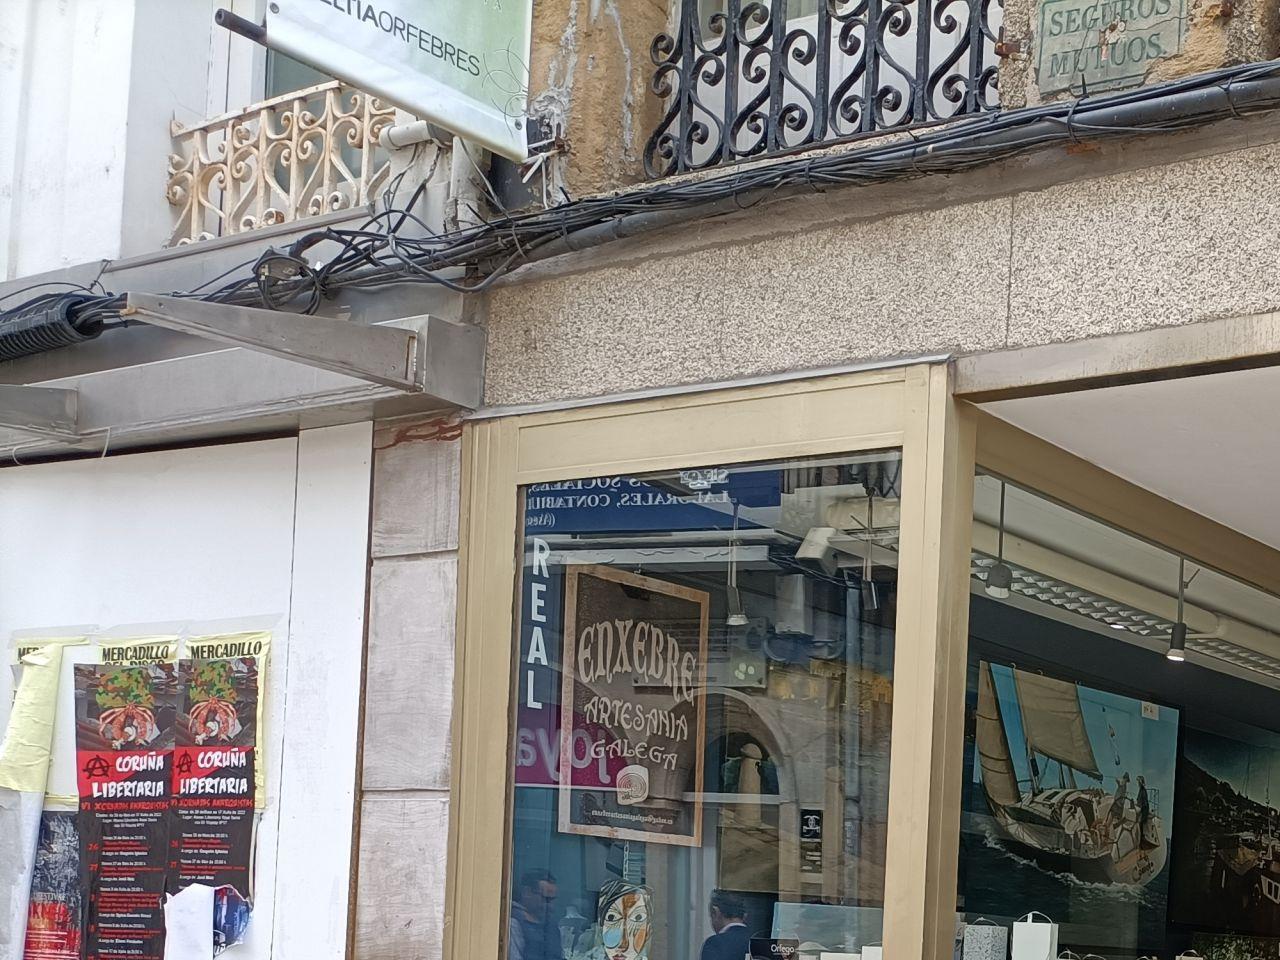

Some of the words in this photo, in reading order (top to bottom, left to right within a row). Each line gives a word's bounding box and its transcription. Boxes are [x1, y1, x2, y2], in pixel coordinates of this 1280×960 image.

[103, 645, 169, 661] MERCADILLO
[191, 641, 262, 659] MERCADILLO
[577, 618, 697, 706] ENXEBRE
[584, 695, 689, 742] ARTESANIA
[116, 751, 164, 772] CORUÑA
[198, 748, 247, 768] CORUÑA
[591, 739, 678, 770] GALEGA
[92, 780, 164, 798] LIBERTARIA
[180, 777, 248, 795] LIBERTARIA
